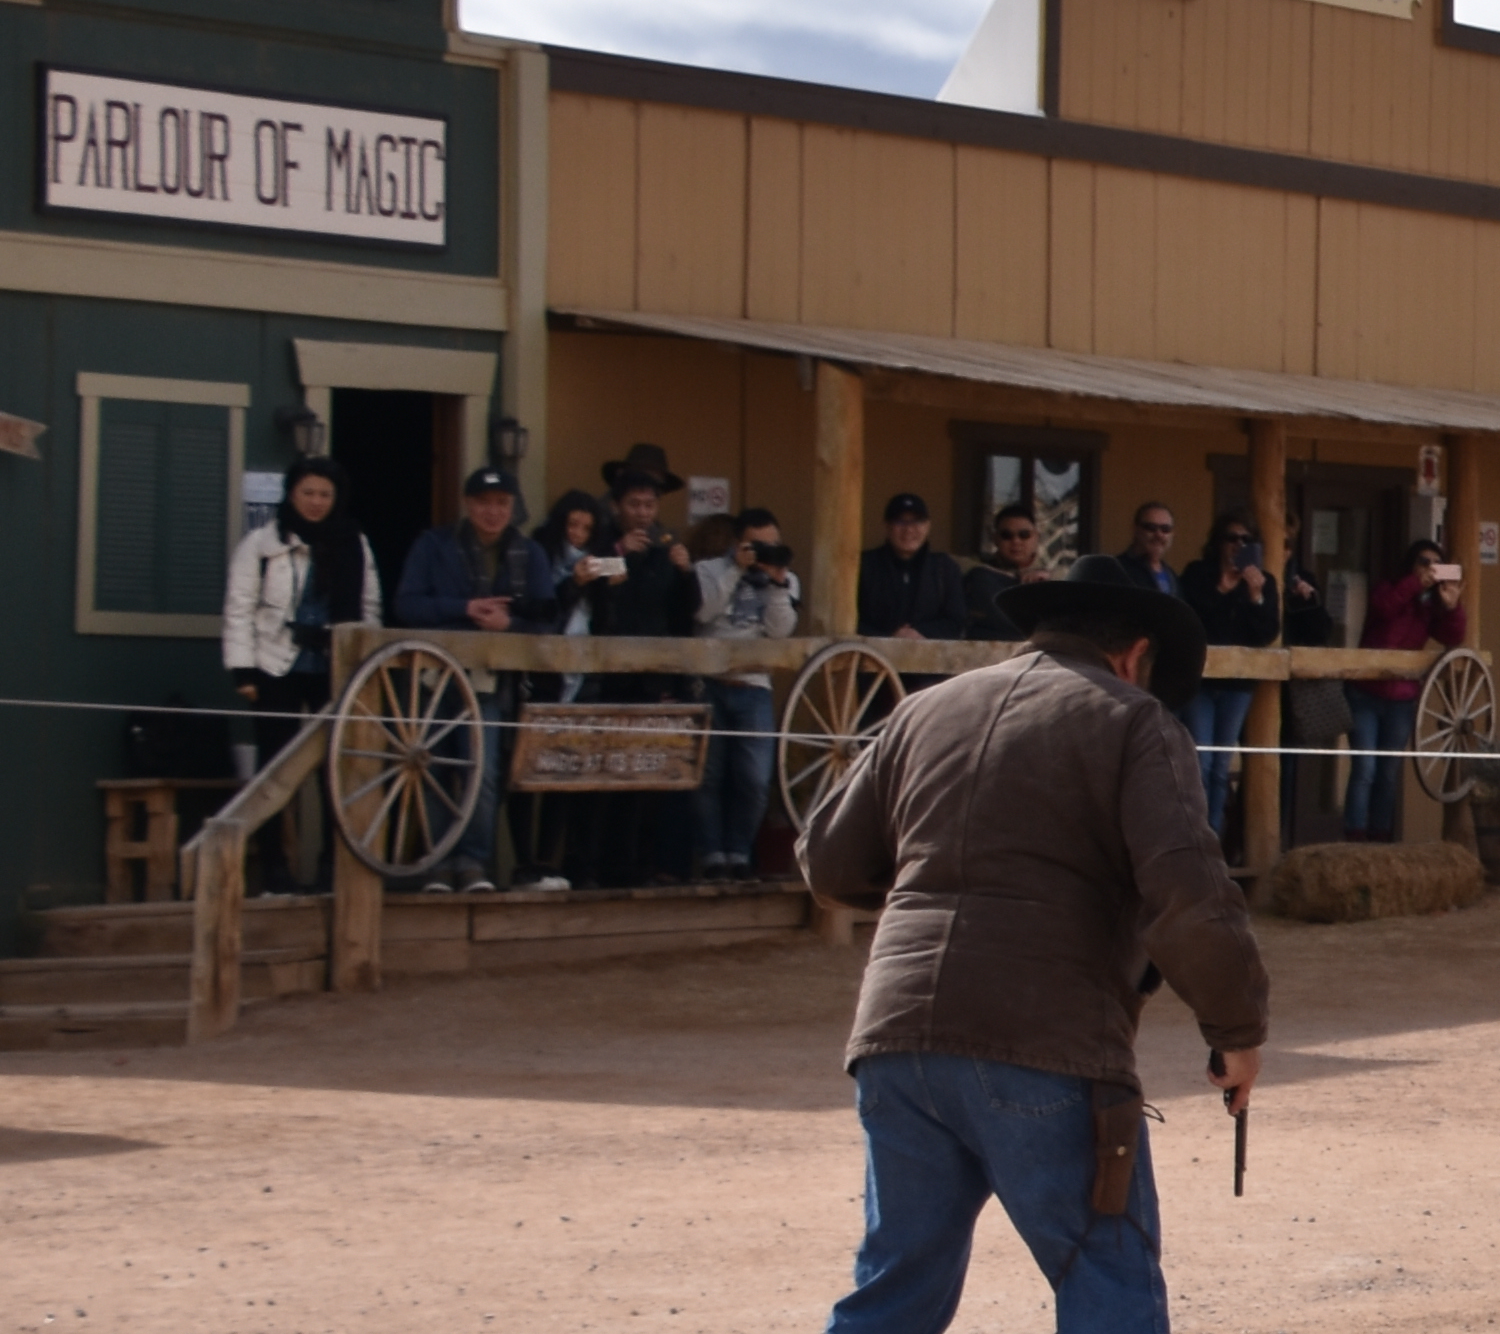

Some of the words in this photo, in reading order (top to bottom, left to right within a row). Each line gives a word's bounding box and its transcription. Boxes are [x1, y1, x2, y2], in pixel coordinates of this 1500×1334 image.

[48, 93, 231, 201] PARLOUR
[254, 118, 304, 208] OF
[324, 126, 446, 222] MAGIC
